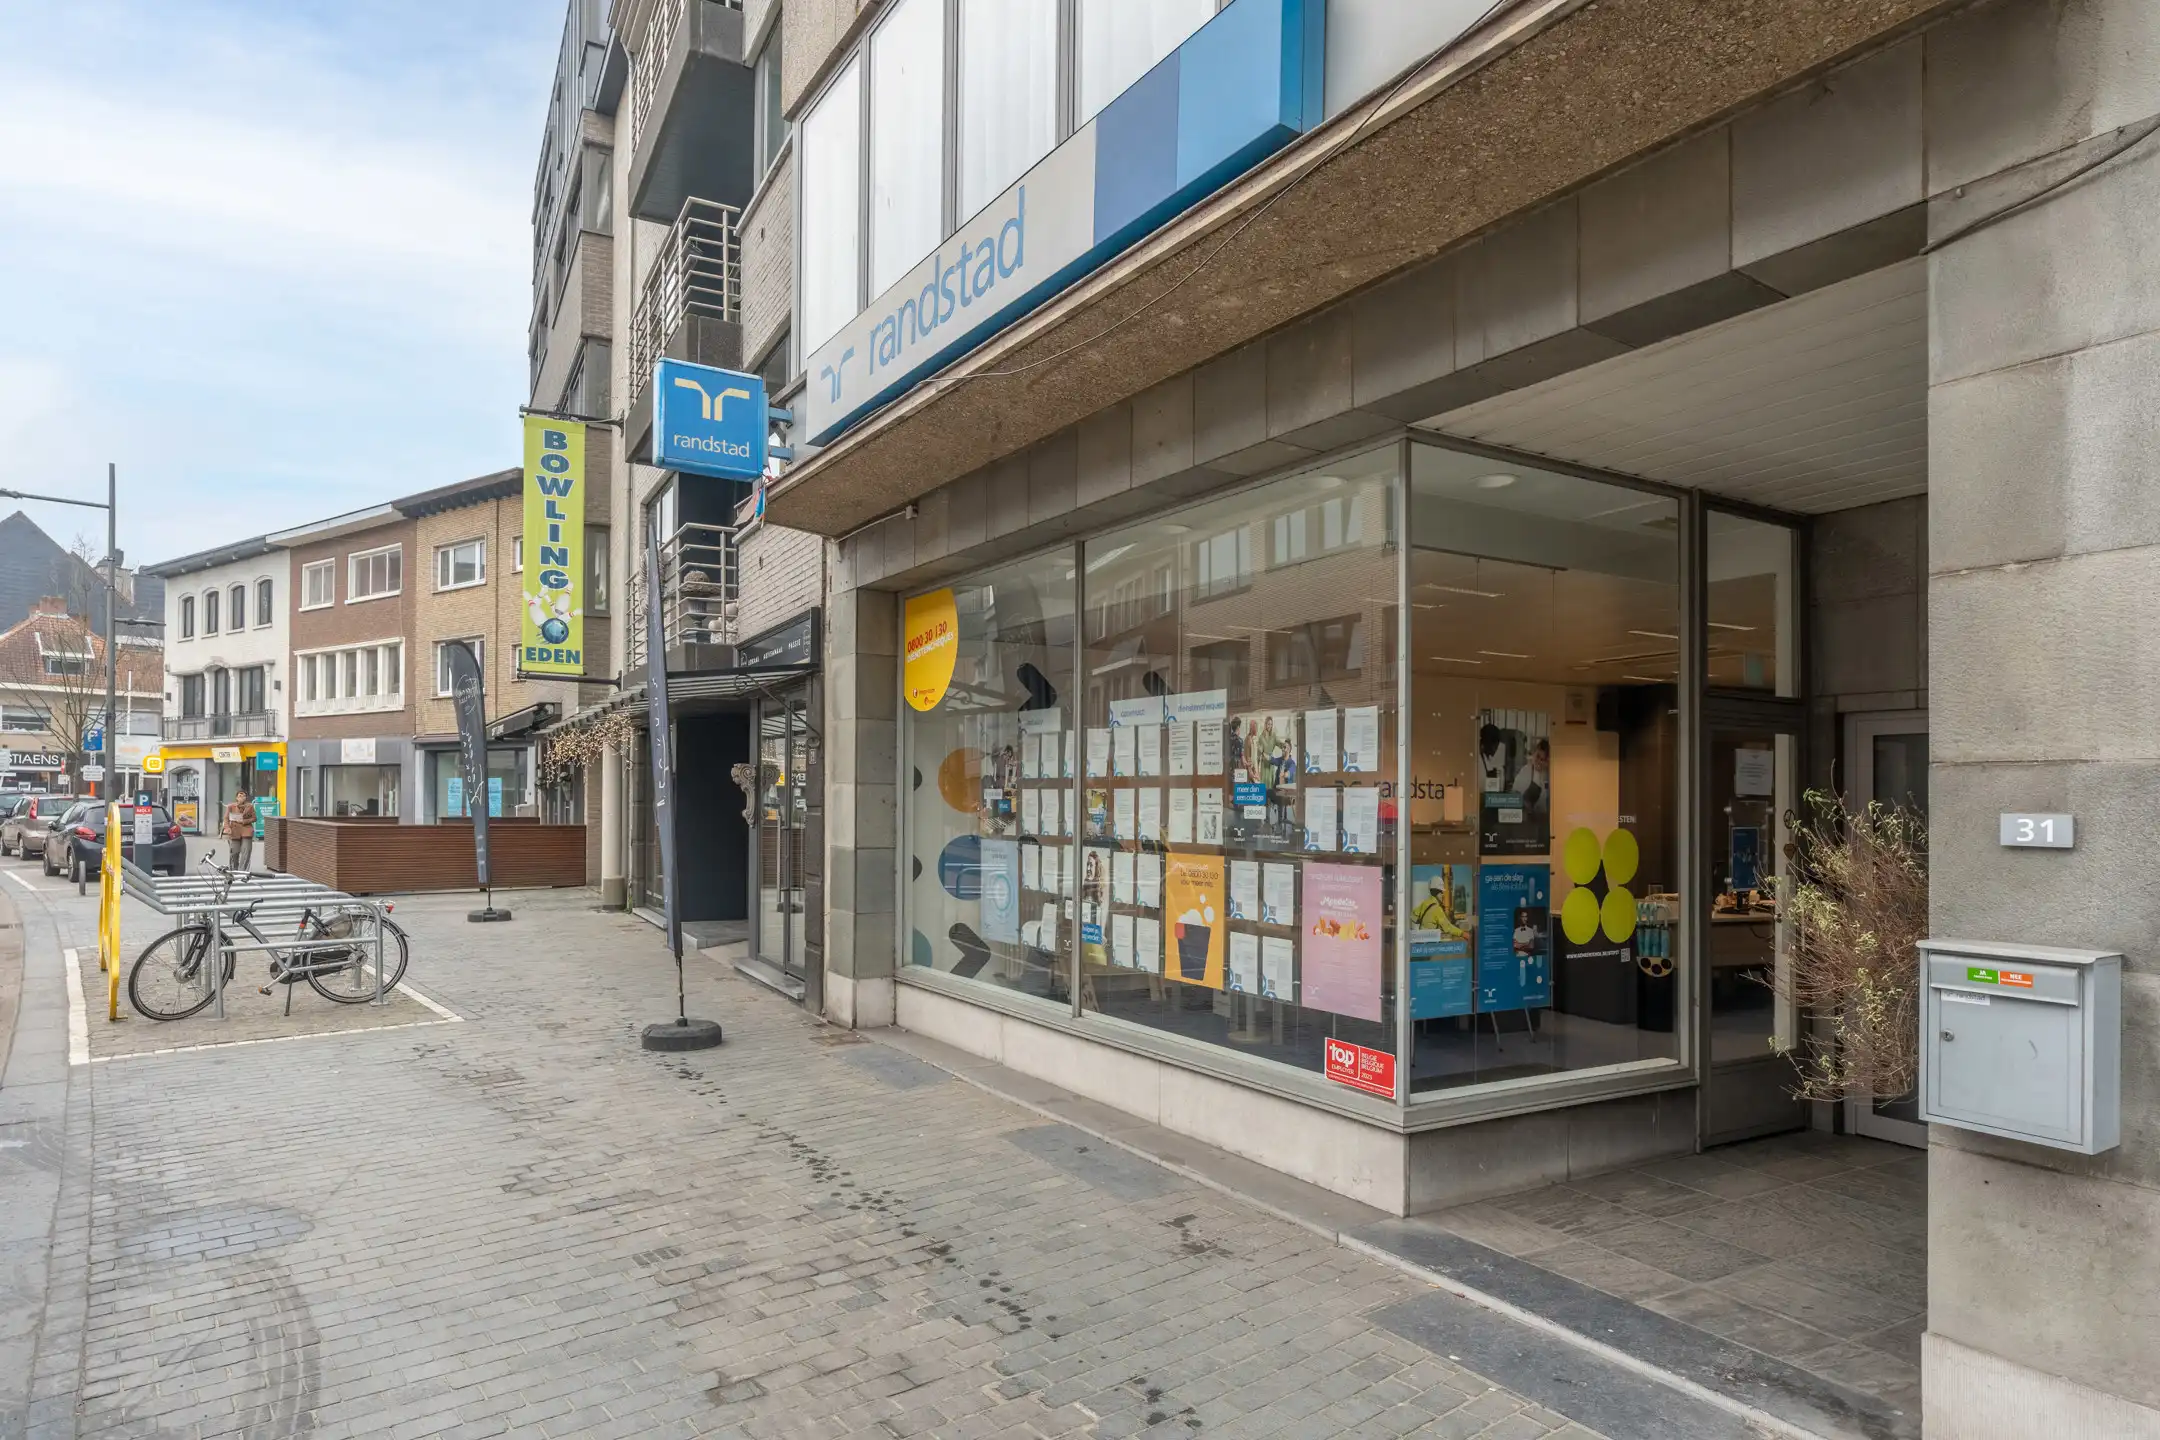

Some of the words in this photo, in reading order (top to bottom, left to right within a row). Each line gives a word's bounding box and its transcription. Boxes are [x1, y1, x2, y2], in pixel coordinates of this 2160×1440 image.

[867, 184, 1026, 376] randstad
[673, 433, 750, 459] randstad
[535, 428, 575, 590] BOWLING
[525, 646, 581, 665] EDEN
[2016, 818, 2054, 843] 31
[1329, 1043, 1355, 1068] top
